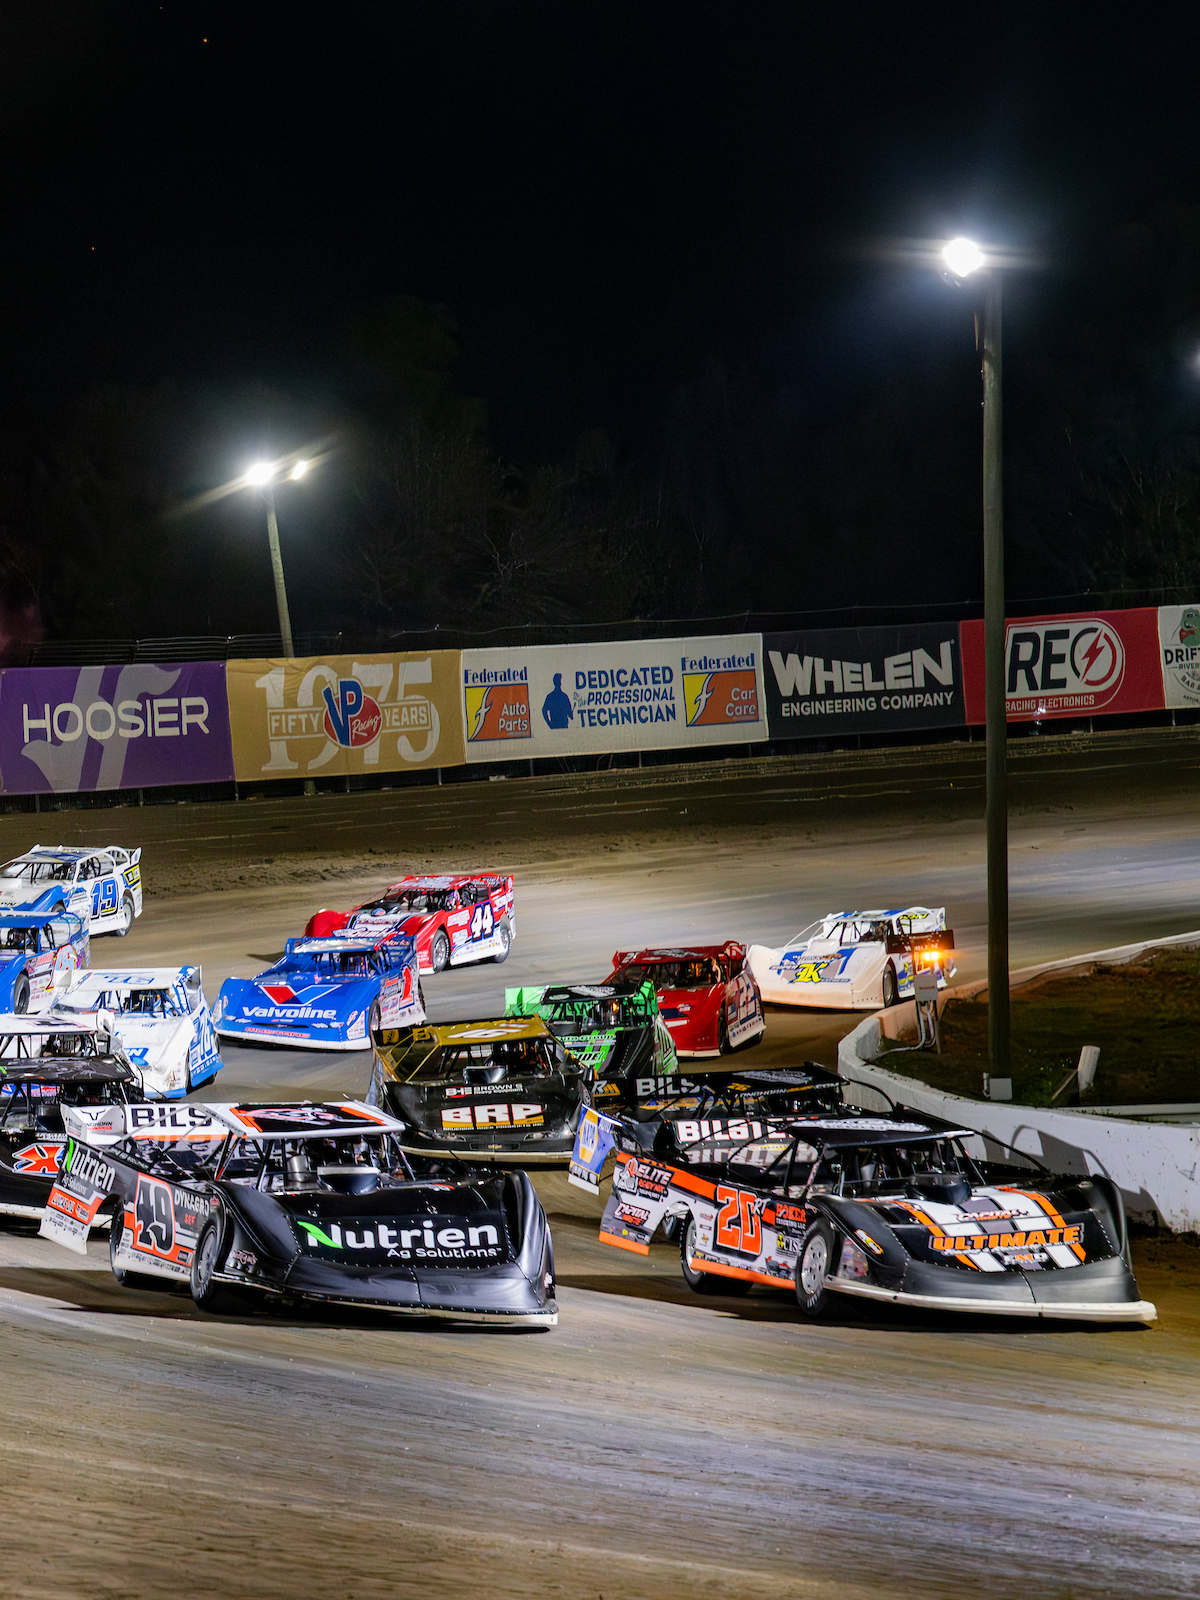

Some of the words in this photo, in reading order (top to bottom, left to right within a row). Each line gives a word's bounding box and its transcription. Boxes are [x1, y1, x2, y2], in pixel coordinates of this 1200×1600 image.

[681, 653, 755, 671] Federated
[1164, 647, 1200, 665] DRIF
[464, 666, 528, 684] Federated
[575, 666, 674, 690] DEDICATED
[768, 641, 954, 697] WHELEN
[587, 686, 675, 706] PROFESSIONAL
[731, 687, 754, 701] Car
[781, 698, 877, 717] ENGINEERING
[880, 692, 954, 709] COMPANY
[1006, 700, 1036, 712] RACING
[1039, 695, 1095, 709] ELECTRONICS
[22, 694, 209, 744] HOOSIER
[322, 679, 364, 747] VP
[384, 706, 428, 727] YEARS
[501, 702, 527, 717] Auto
[577, 703, 676, 728] TECHNICIAN
[726, 702, 756, 717] Care
[271, 713, 320, 734] FIFTY
[499, 717, 528, 732] Parts
[90, 879, 119, 920] 19
[471, 902, 494, 940] 44
[242, 1003, 338, 1020] Valvoline
[441, 1103, 544, 1126] BRP
[677, 1117, 790, 1142] BILSTE
[61, 1136, 116, 1193] Nutrien
[637, 1163, 672, 1186] ELITE
[298, 1219, 498, 1250] Nutrien
[933, 1226, 1080, 1250] ULTIMATE
[386, 1248, 411, 1259] Ag
[414, 1247, 497, 1258] Solutions
